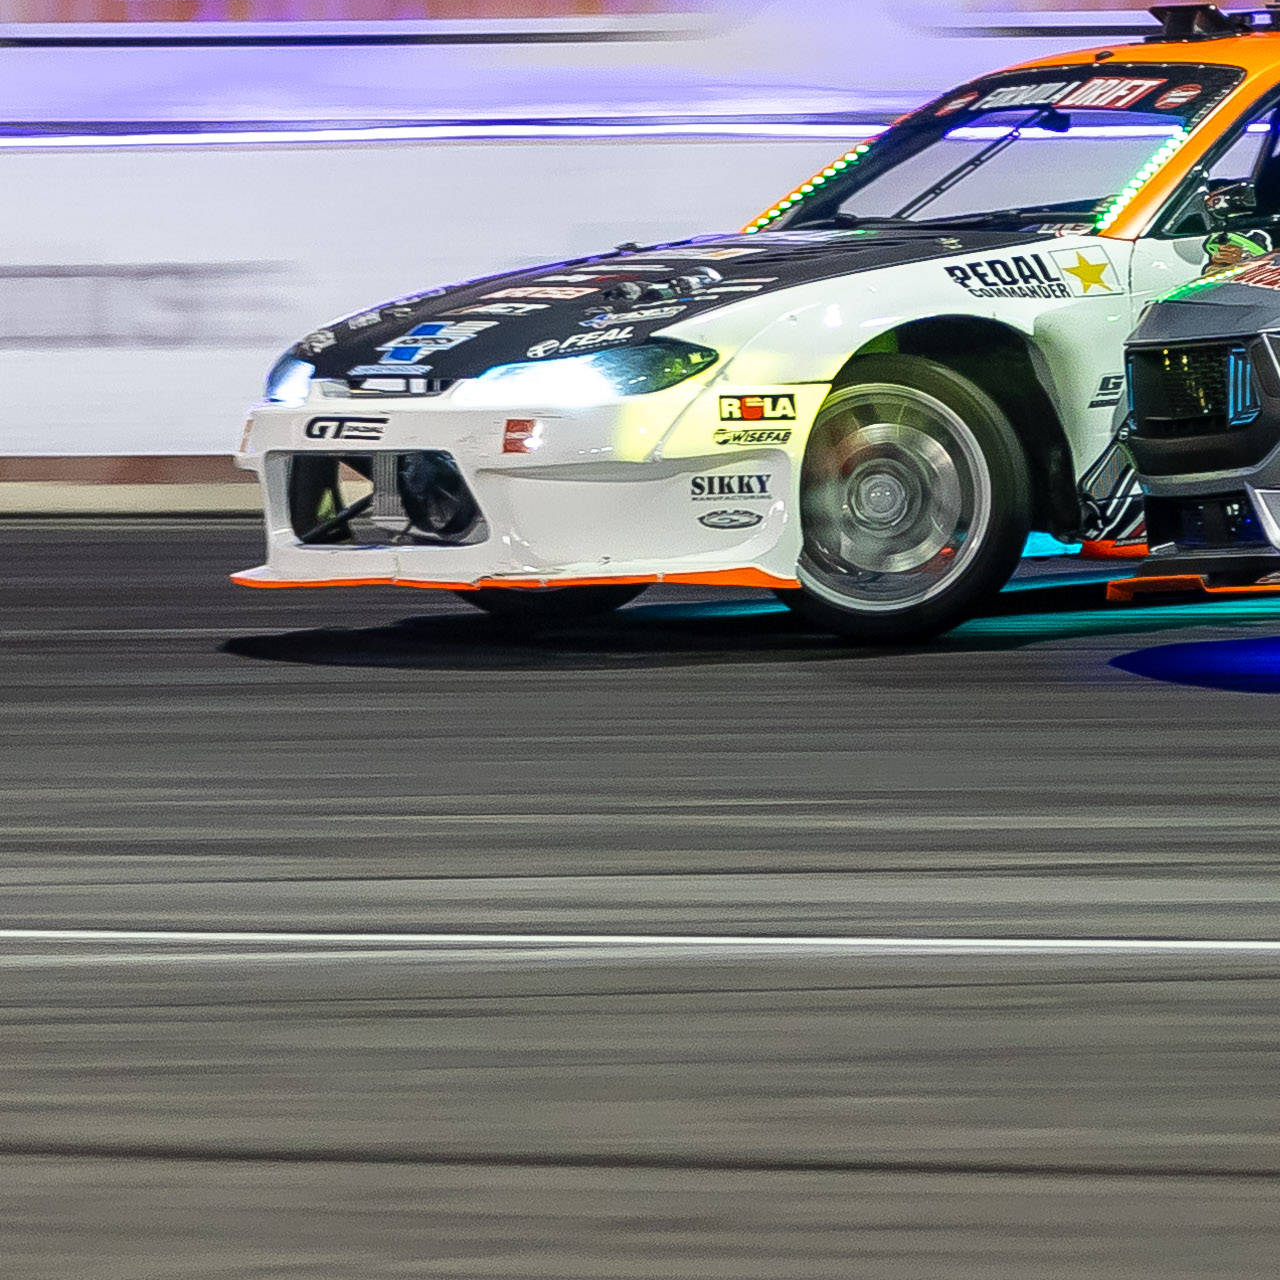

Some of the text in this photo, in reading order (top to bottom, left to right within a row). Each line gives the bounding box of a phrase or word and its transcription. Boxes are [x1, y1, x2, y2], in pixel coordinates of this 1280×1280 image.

[1056, 77, 1163, 108] DRIFT
[944, 254, 1061, 289] PEDAL
[968, 283, 1072, 299] COMMANDER
[560, 326, 634, 349] FEAL
[732, 431, 792, 442] WISEFAB
[691, 474, 771, 495] SIKKY
